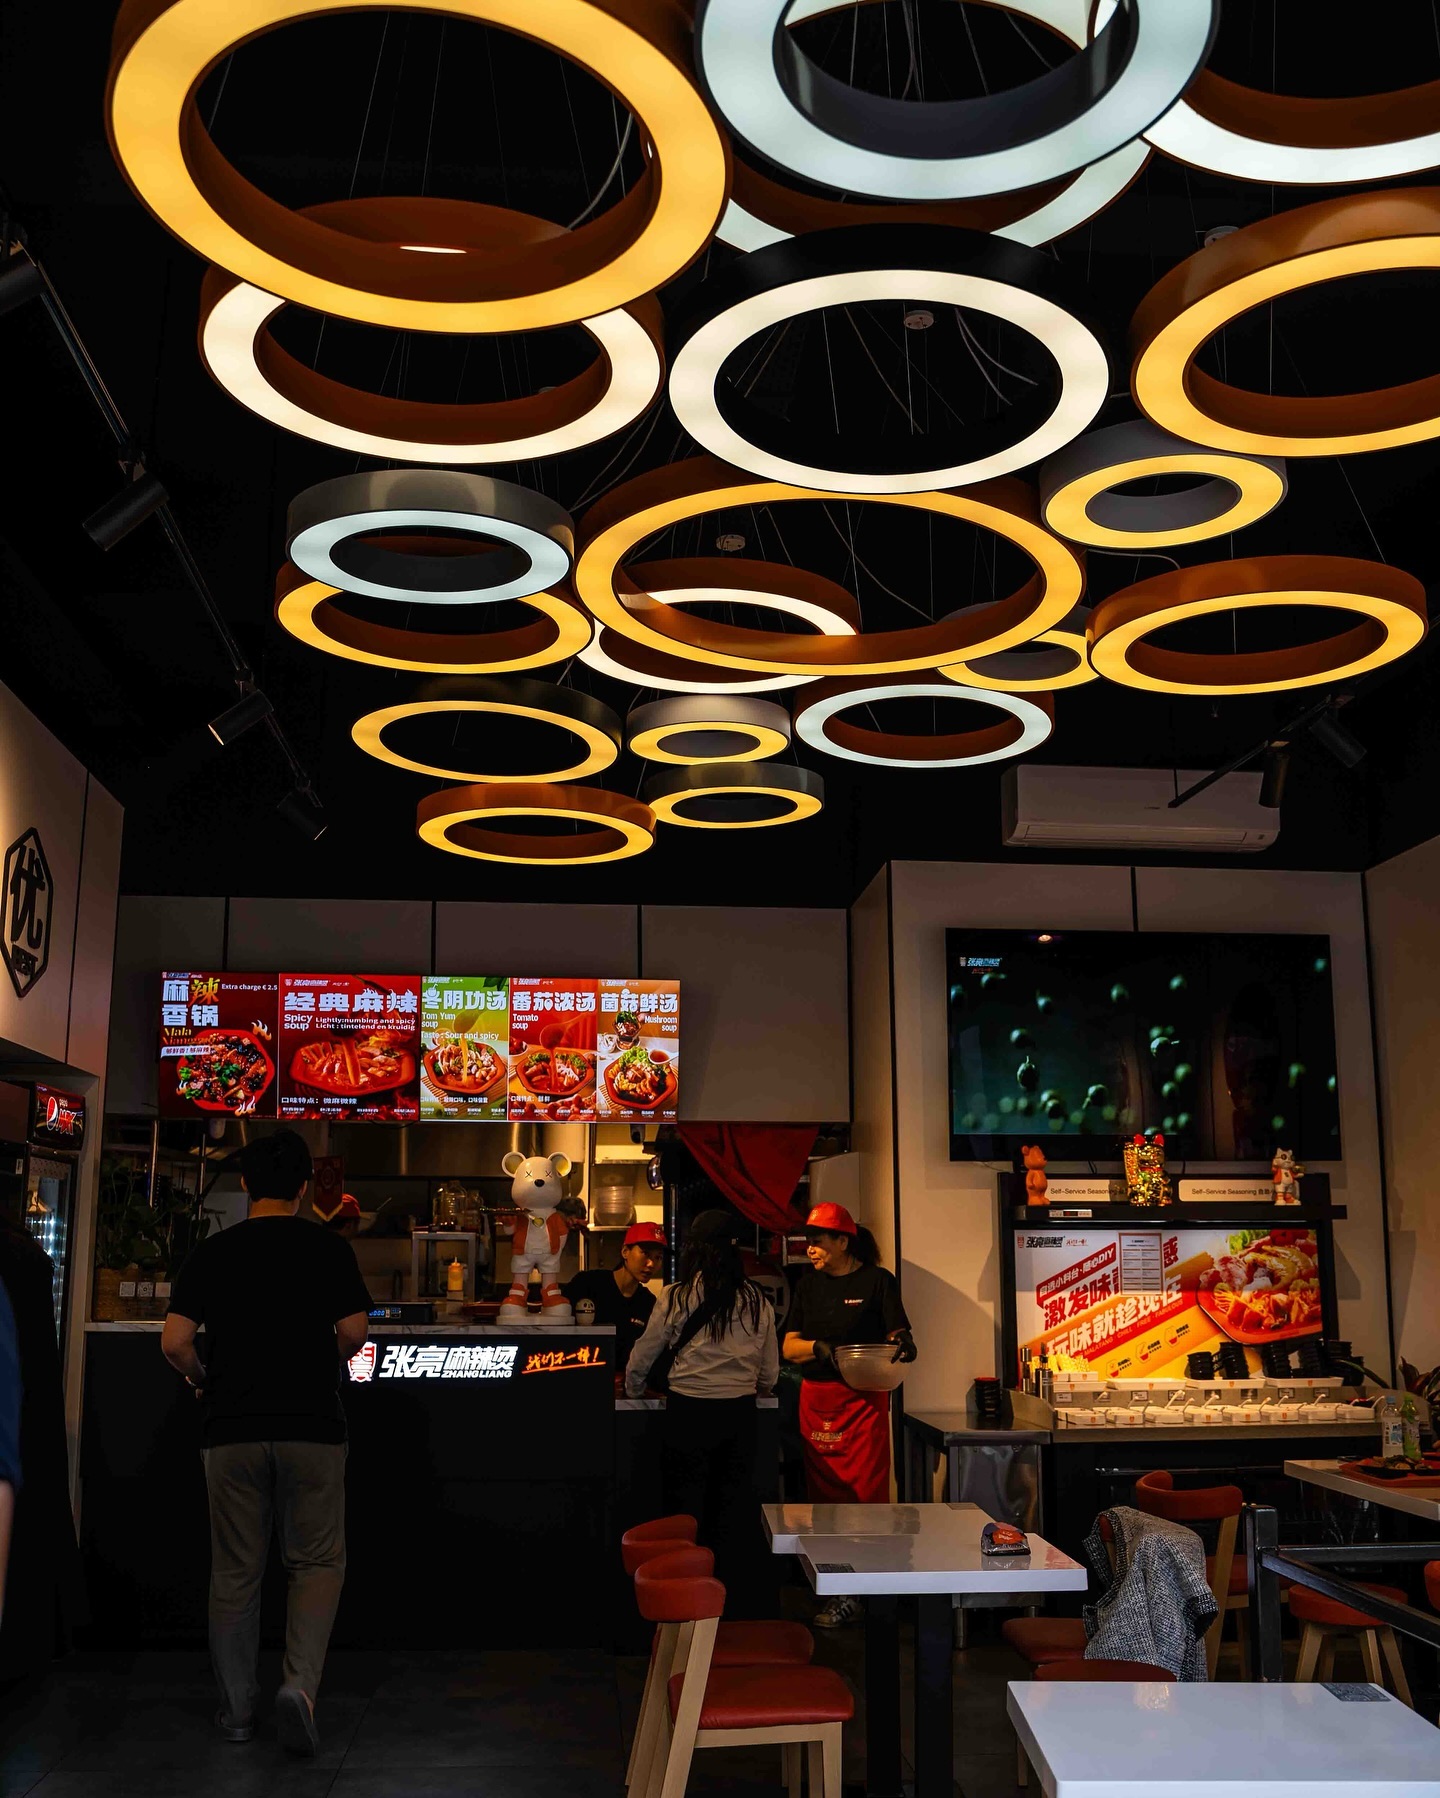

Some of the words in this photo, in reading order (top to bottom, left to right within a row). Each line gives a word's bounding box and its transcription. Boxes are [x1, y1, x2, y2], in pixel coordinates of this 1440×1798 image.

[162, 978, 220, 1007] 麻辣
[284, 988, 418, 1013] 经典麻辣
[512, 991, 596, 1012] 番茄浓汤
[601, 988, 678, 1013] 菌菇鲜汤
[162, 1004, 219, 1027] 香锅
[284, 1014, 313, 1023] Spicy
[422, 1012, 437, 1020] Tom
[440, 1012, 456, 1020] Yum
[513, 1013, 539, 1022] Tomato
[644, 1015, 677, 1024] Mushroom
[284, 1022, 309, 1031] soup
[421, 1021, 438, 1029] soup
[512, 1022, 529, 1031] soup
[661, 1024, 677, 1033] soup
[480, 1032, 499, 1041] spicy
[1228, 1188, 1257, 1196] Seasoning
[379, 1345, 519, 1378] 张亮麻辣烫
[441, 1370, 512, 1378] ZHANGLIANG
